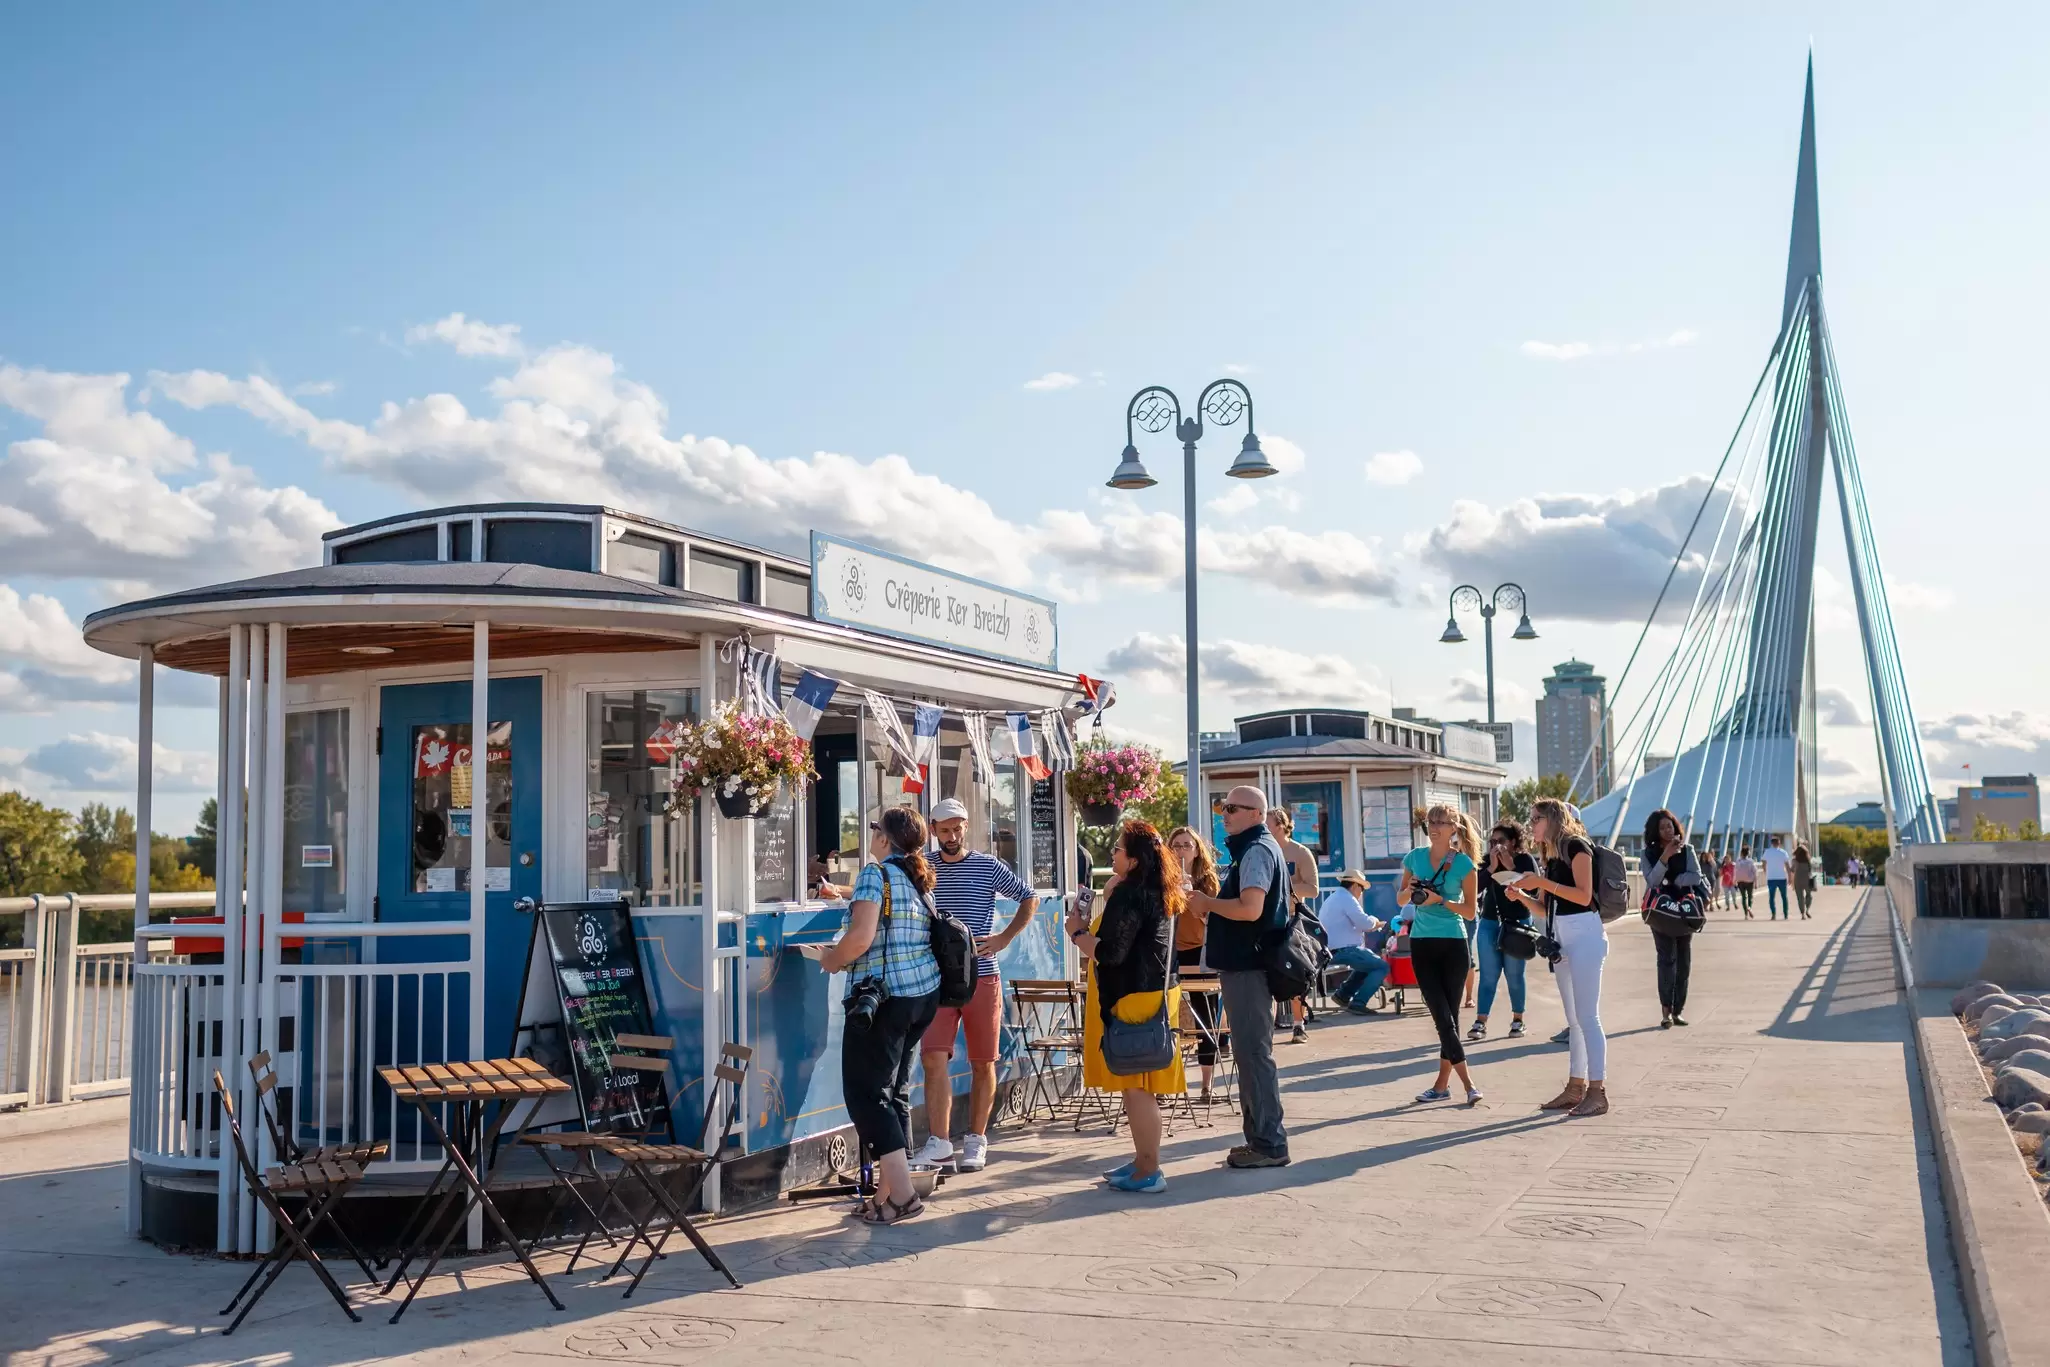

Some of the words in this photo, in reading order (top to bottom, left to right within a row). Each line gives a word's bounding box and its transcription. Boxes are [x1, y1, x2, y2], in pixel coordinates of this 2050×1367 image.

[885, 579, 941, 625] Crêperie
[947, 595, 968, 626] Ker
[973, 599, 1010, 641] Breizh
[453, 748, 502, 767] CADA
[618, 1071, 640, 1087] Local
